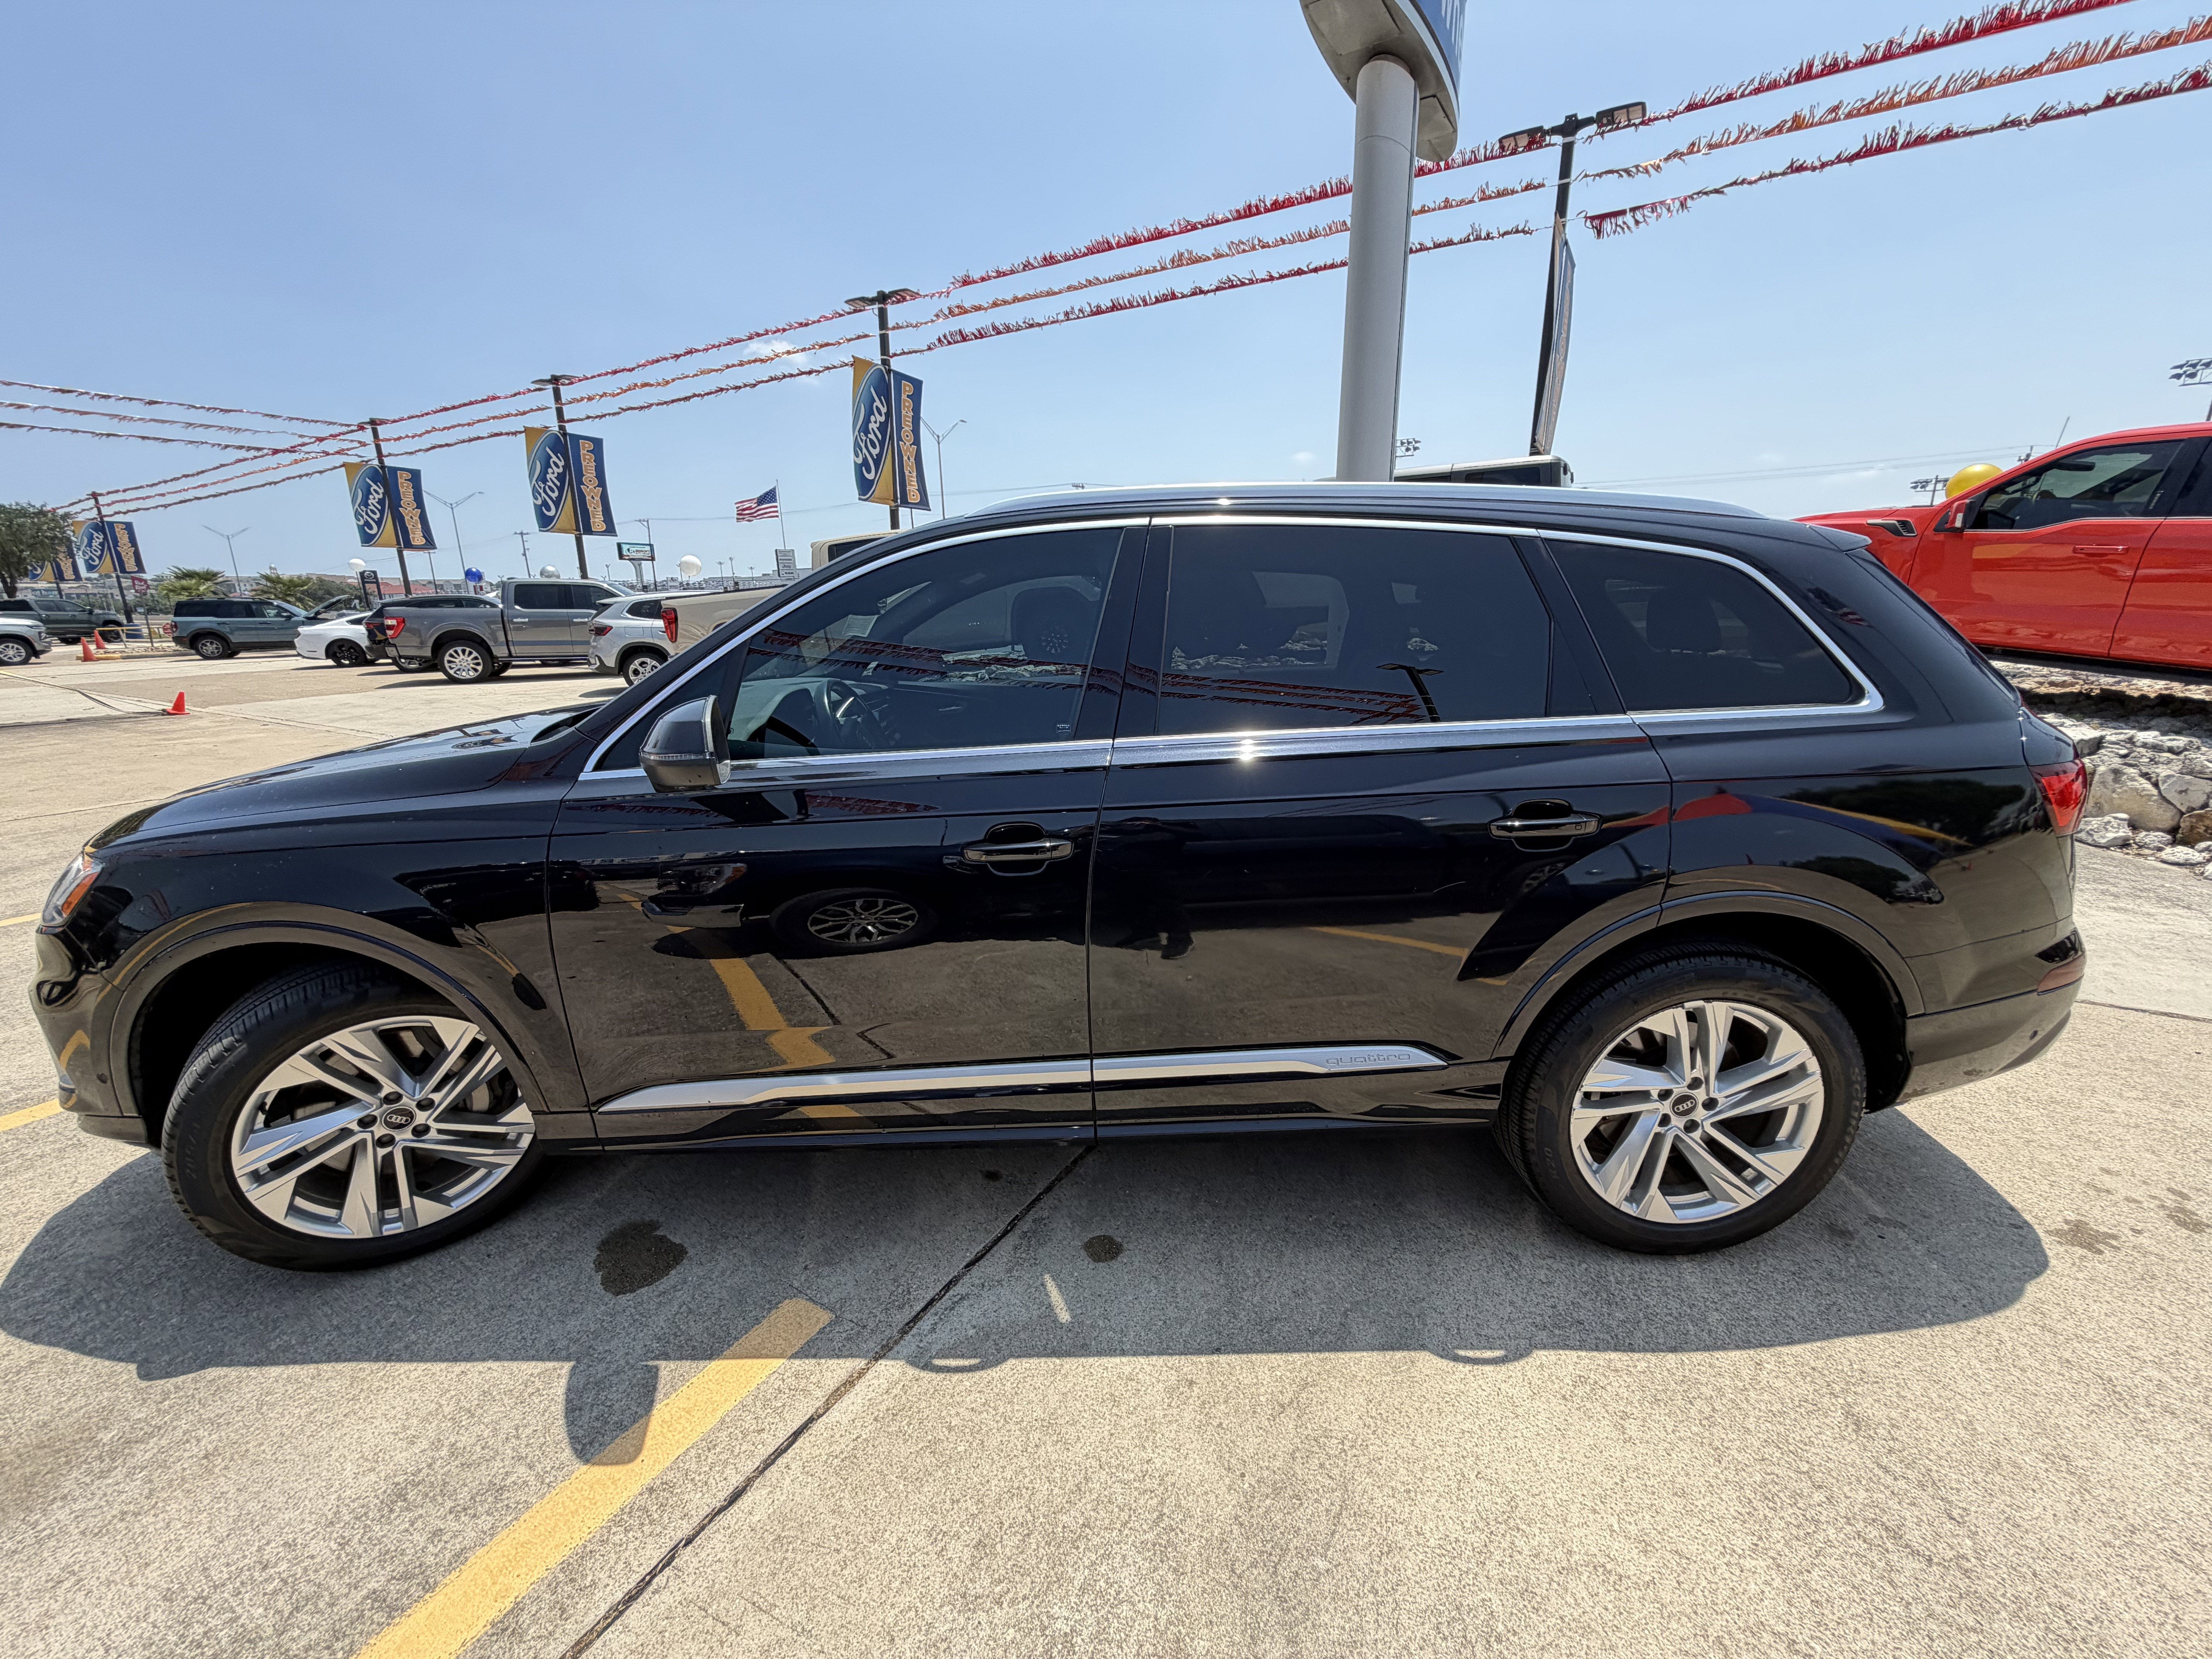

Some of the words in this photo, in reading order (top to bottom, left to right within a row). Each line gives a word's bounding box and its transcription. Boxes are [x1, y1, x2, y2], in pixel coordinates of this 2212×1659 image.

[853, 385, 887, 480] Ford
[900, 380, 921, 503] PREOWNED
[354, 477, 384, 534] Ford
[397, 471, 426, 545] PREOWNED
[531, 446, 565, 516] Ford
[579, 440, 606, 531] PREOWNED
[80, 528, 104, 565] Ford
[1326, 1053, 1410, 1066] quattro
